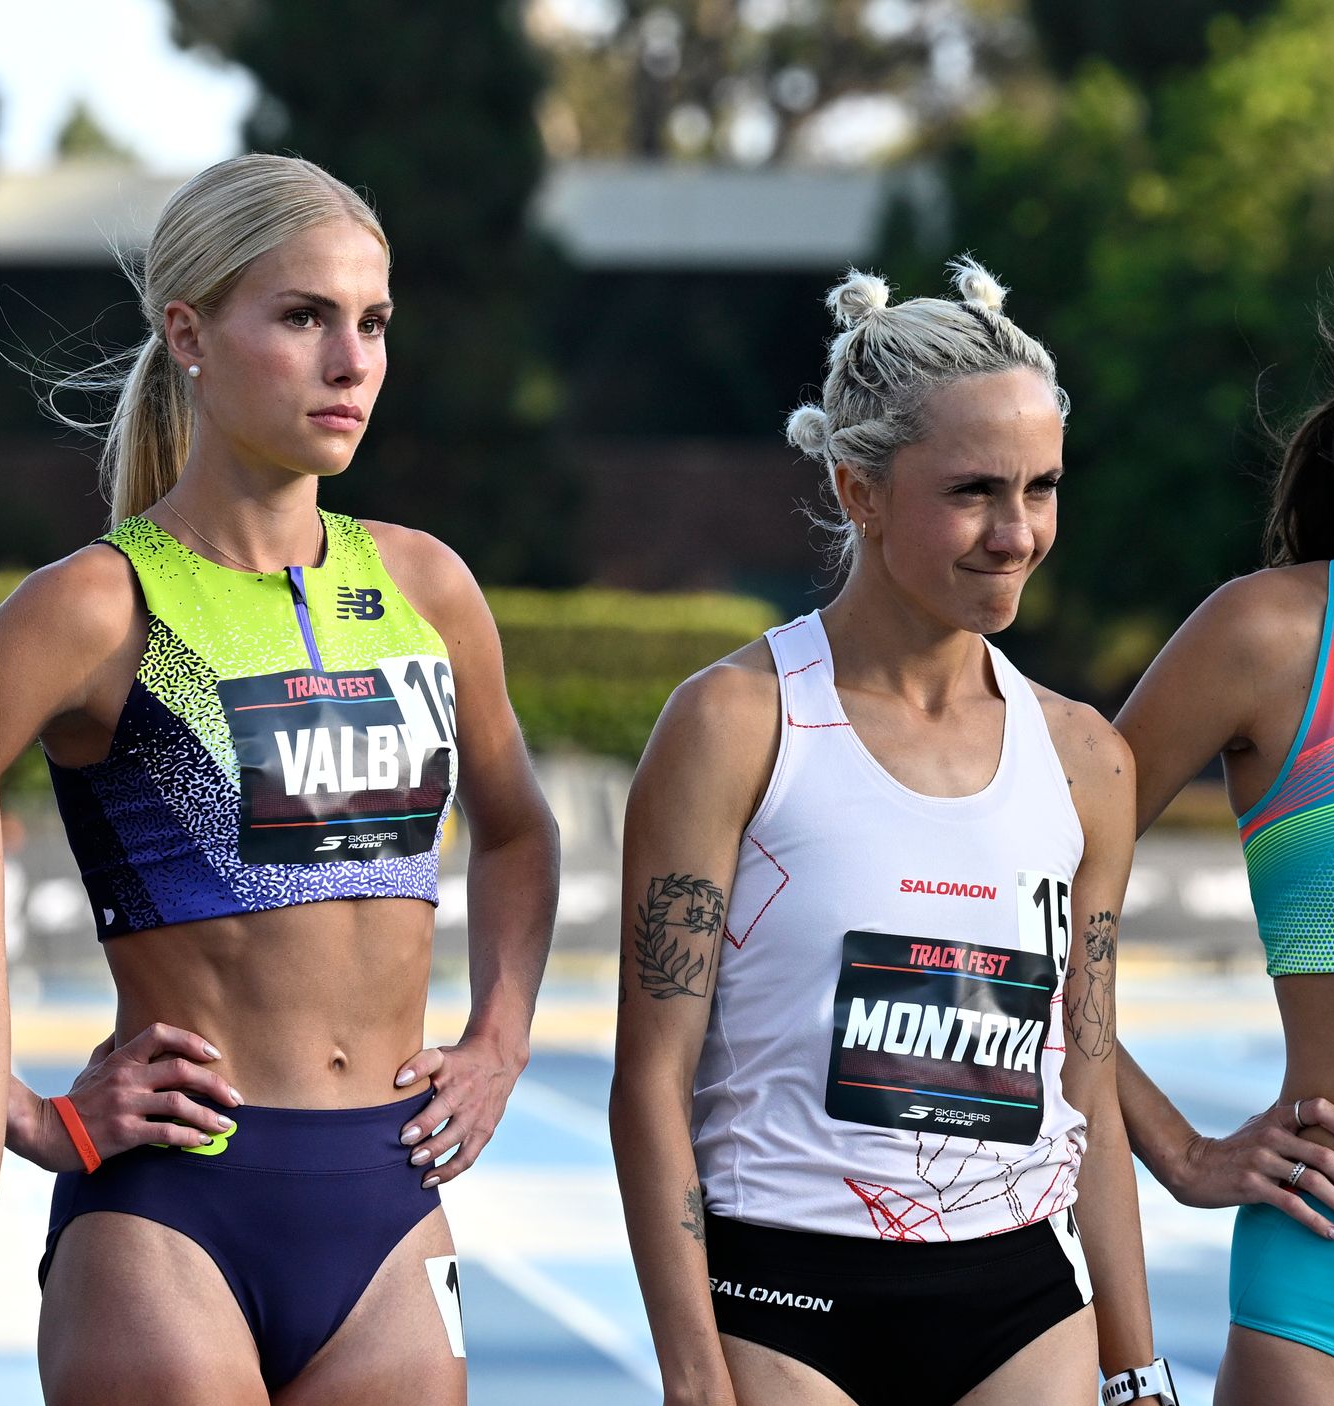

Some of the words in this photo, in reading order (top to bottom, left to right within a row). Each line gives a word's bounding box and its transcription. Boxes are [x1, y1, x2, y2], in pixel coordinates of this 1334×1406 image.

[284, 677, 337, 700] TRACK
[338, 677, 376, 698] FEST
[274, 723, 428, 796] VALBY
[348, 832, 398, 843] SKECHERS
[899, 879, 997, 900] SALOMON
[1032, 878, 1069, 973] 15
[910, 944, 964, 970] TRACK
[967, 950, 1010, 976] FEST
[842, 997, 1044, 1074] MONTOYA
[935, 1108, 991, 1122] SKECHERS
[708, 1277, 833, 1312] SALOMON
